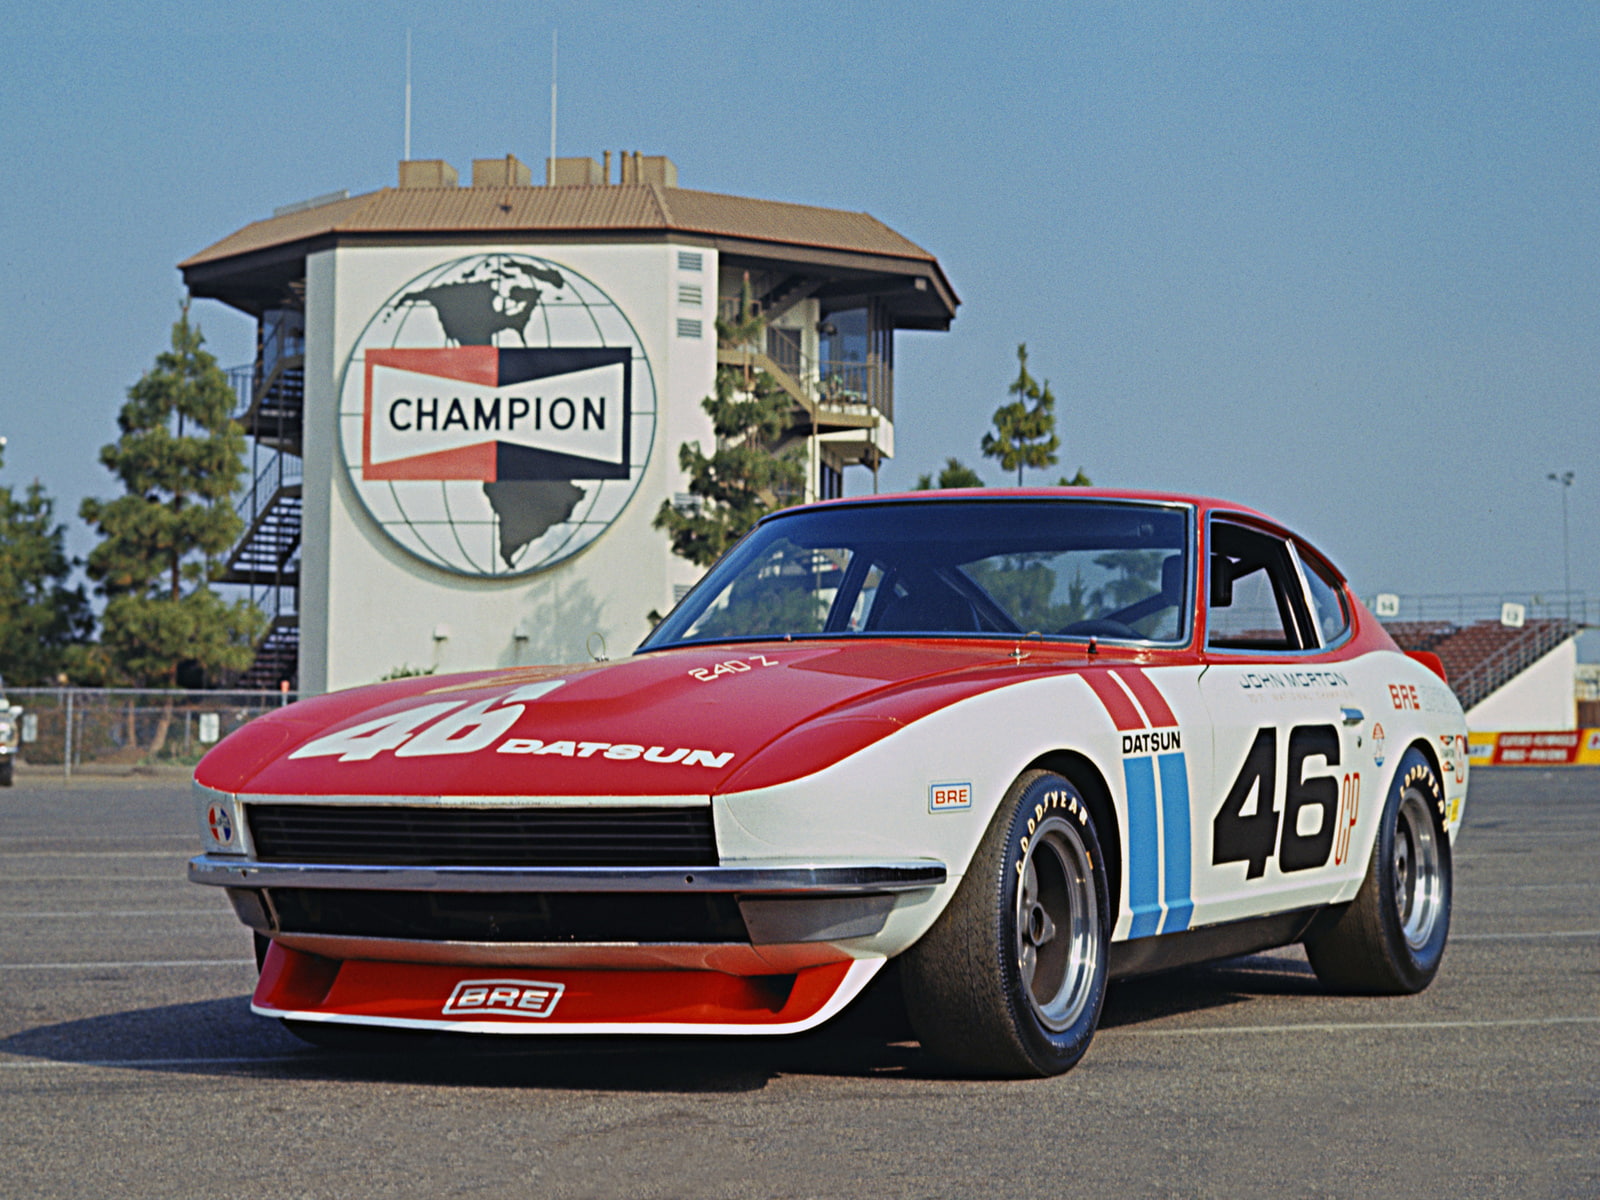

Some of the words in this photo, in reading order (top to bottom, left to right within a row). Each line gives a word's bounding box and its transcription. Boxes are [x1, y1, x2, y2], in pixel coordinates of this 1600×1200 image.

[389, 397, 606, 431] CHAMPION
[688, 660, 751, 681] 240
[749, 655, 779, 667] Z
[1239, 674, 1286, 688] JOHN
[1283, 672, 1349, 687] MORTON
[1388, 684, 1421, 710] BRE
[288, 680, 566, 762] 46
[496, 738, 735, 769] DATSUN
[1122, 731, 1181, 754] DATSUN
[935, 789, 968, 805] BRE
[1212, 724, 1341, 881] 46
[1016, 790, 1089, 877] GOODYEAR
[1335, 772, 1360, 867] CP
[458, 987, 551, 1011] BRE
